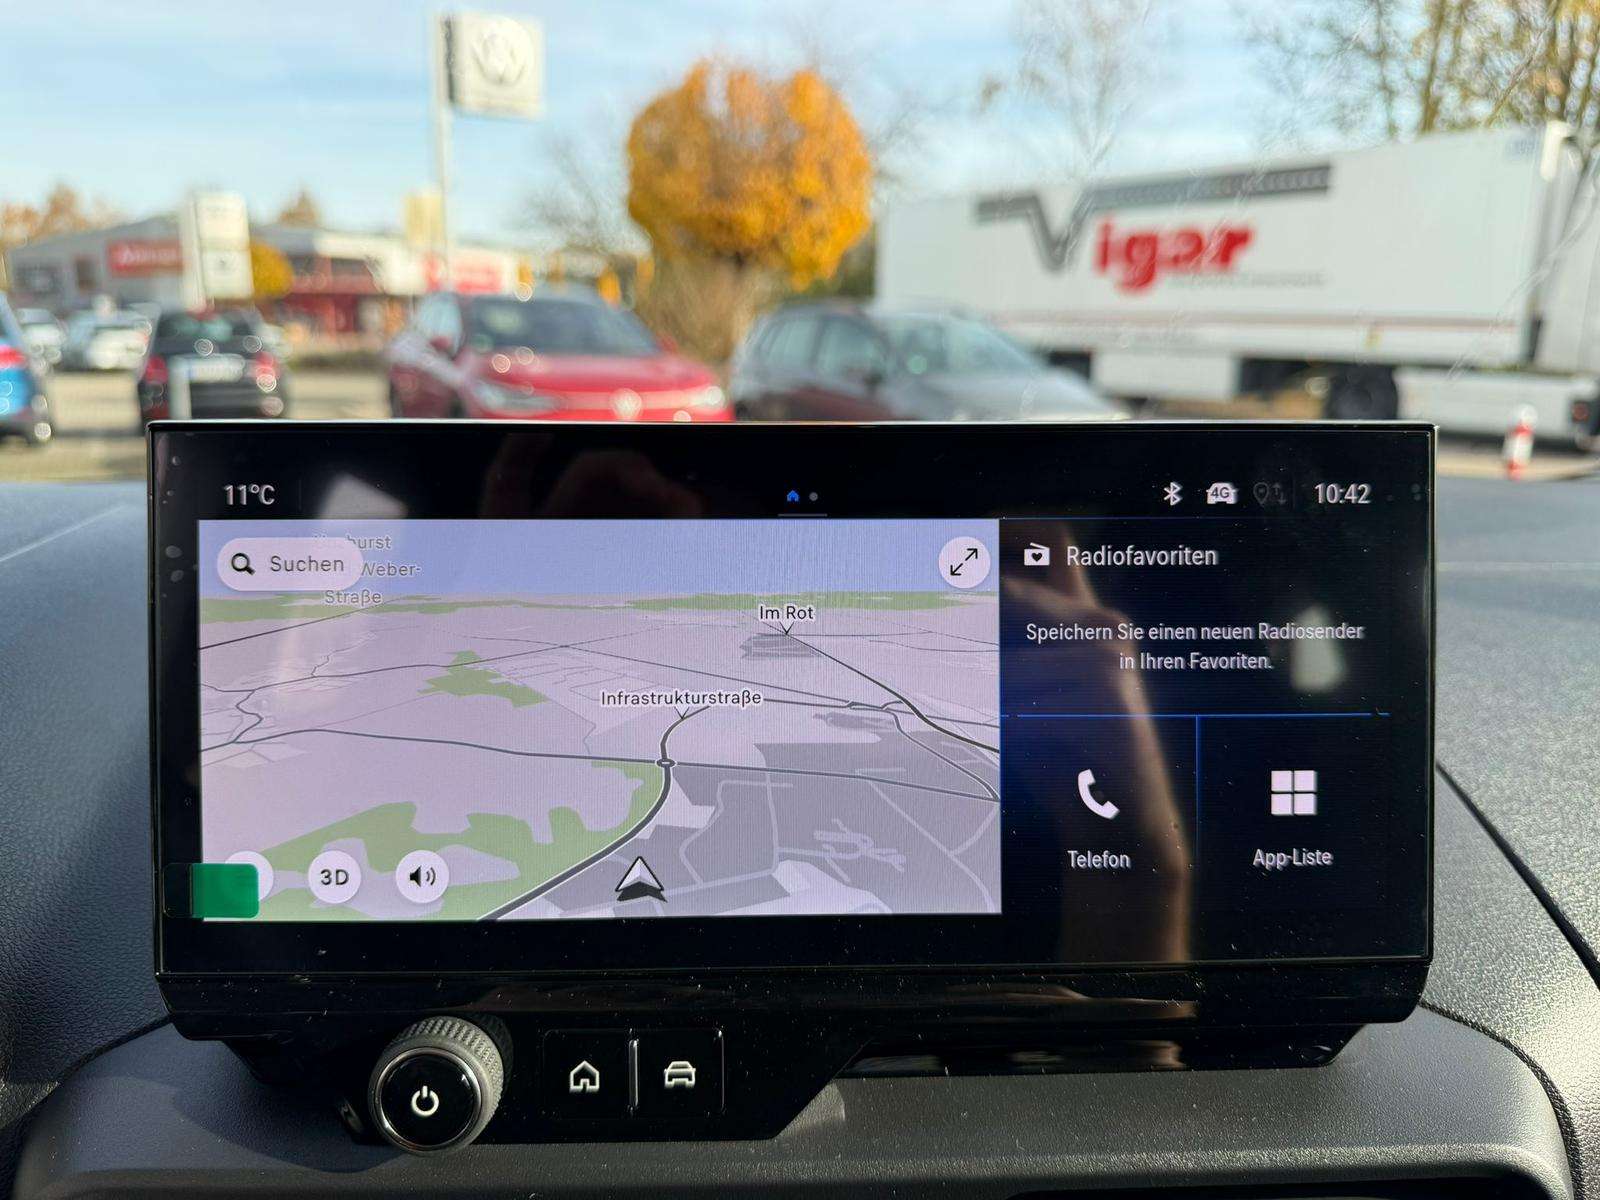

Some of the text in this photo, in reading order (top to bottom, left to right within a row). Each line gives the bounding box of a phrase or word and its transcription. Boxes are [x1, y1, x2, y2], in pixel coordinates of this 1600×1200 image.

[223, 484, 276, 506] 11°C
[1210, 486, 1230, 500] 4G
[1314, 483, 1371, 505] 10:42
[269, 555, 345, 573] Suchen
[1065, 545, 1219, 566] Radiofavoriten
[324, 589, 382, 606] Straße
[759, 606, 813, 620] Im Rot
[1026, 622, 1365, 644] Speichern Sie einen neuen Radiosender
[1119, 652, 1273, 670] in Ihren Favoriten.
[601, 690, 762, 707] Infrastrukturstraße
[1067, 849, 1131, 869] Telefon
[1252, 847, 1334, 871] App-Liste
[320, 868, 349, 886] 3D
